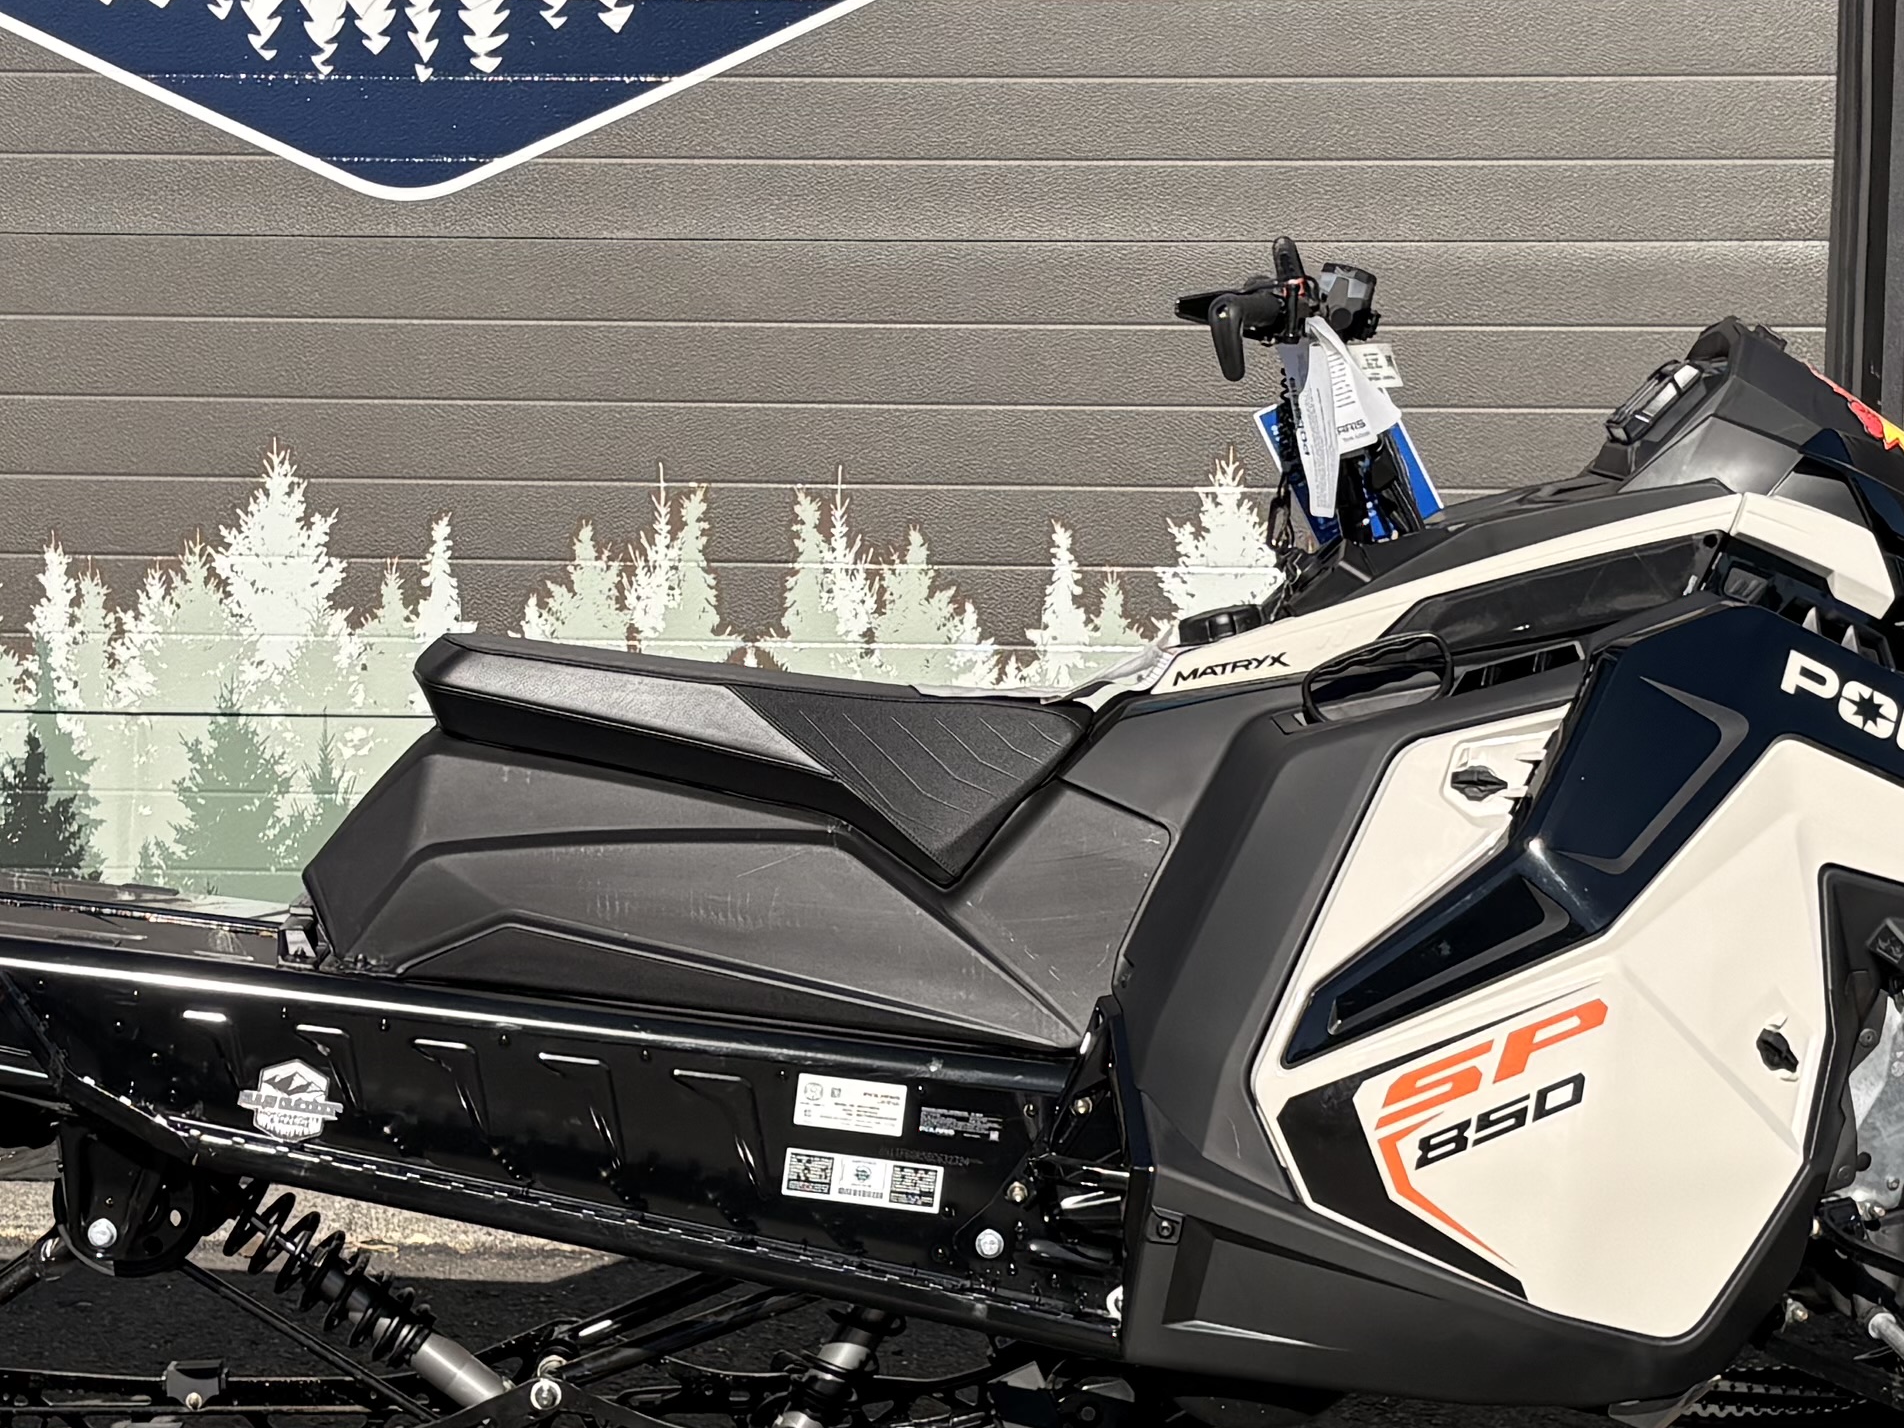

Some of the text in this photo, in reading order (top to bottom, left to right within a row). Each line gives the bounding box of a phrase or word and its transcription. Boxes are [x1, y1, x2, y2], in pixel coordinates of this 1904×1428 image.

[1172, 651, 1291, 687] MATRYX
[1374, 998, 1609, 1131] SP
[1414, 1072, 1586, 1171] 850
